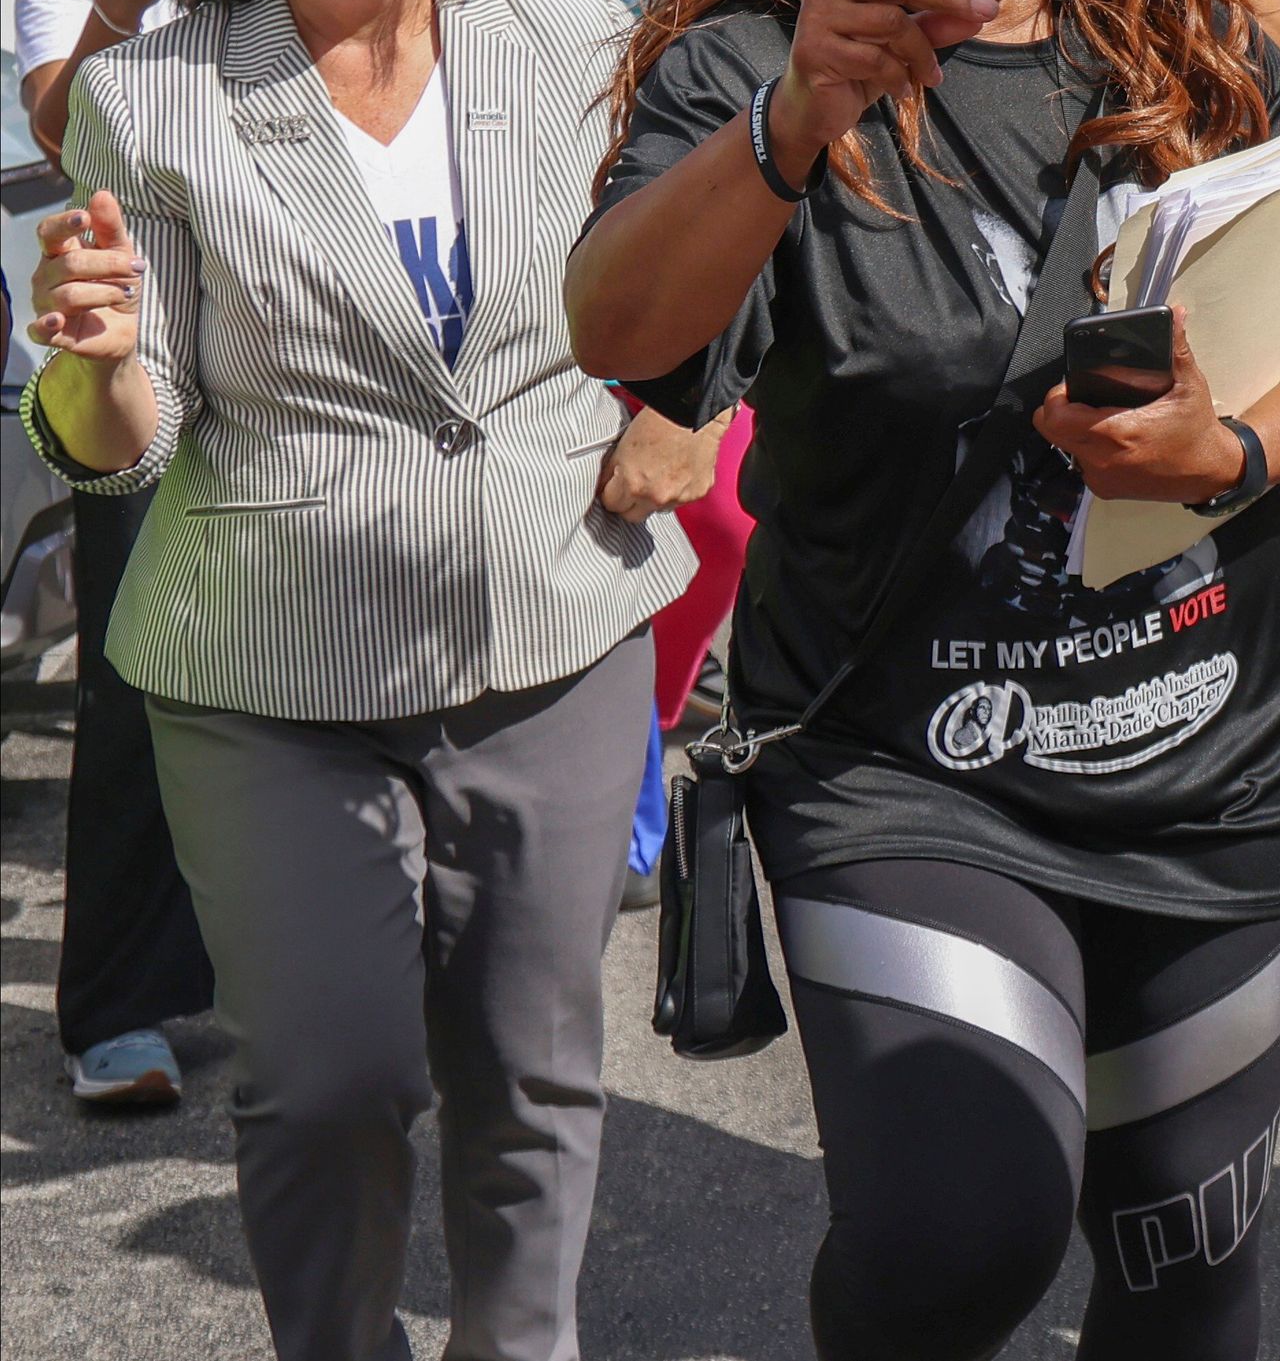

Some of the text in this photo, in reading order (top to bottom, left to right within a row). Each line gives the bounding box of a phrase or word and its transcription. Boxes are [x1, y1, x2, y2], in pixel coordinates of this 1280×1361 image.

[751, 85, 769, 165] TEAMSTERS
[931, 582, 1228, 669] LET MY PEOPLE VOTE
[1031, 682, 1222, 753] Miami-Dade Chapter
[1035, 654, 1226, 729] Phillip Randolph Institute
